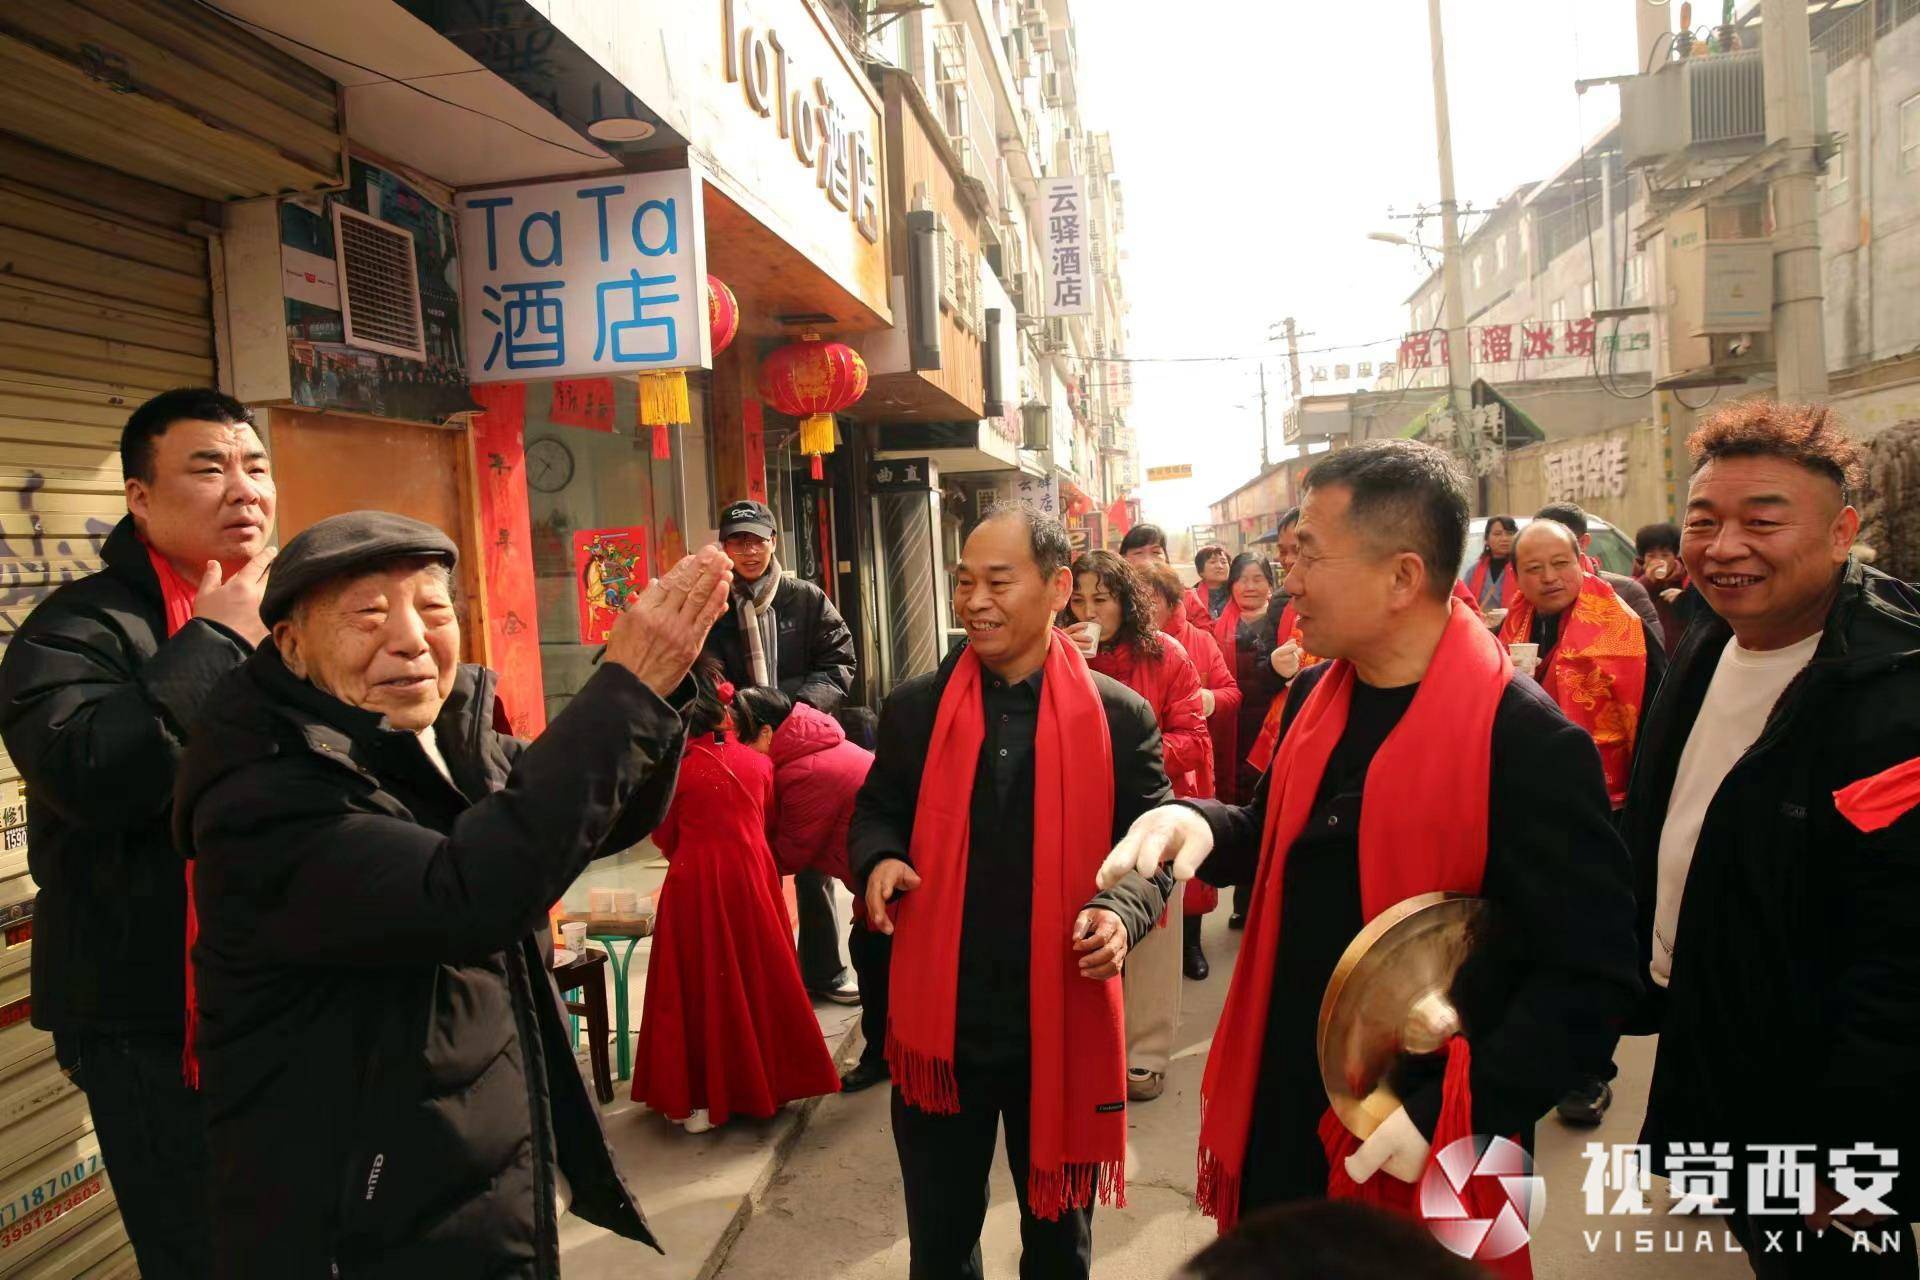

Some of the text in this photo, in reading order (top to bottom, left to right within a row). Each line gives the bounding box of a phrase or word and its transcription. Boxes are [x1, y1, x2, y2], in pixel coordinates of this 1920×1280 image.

[467, 185, 678, 271] TaTa
[1048, 185, 1082, 307] 云驿酒店
[483, 268, 680, 371] 酒店
